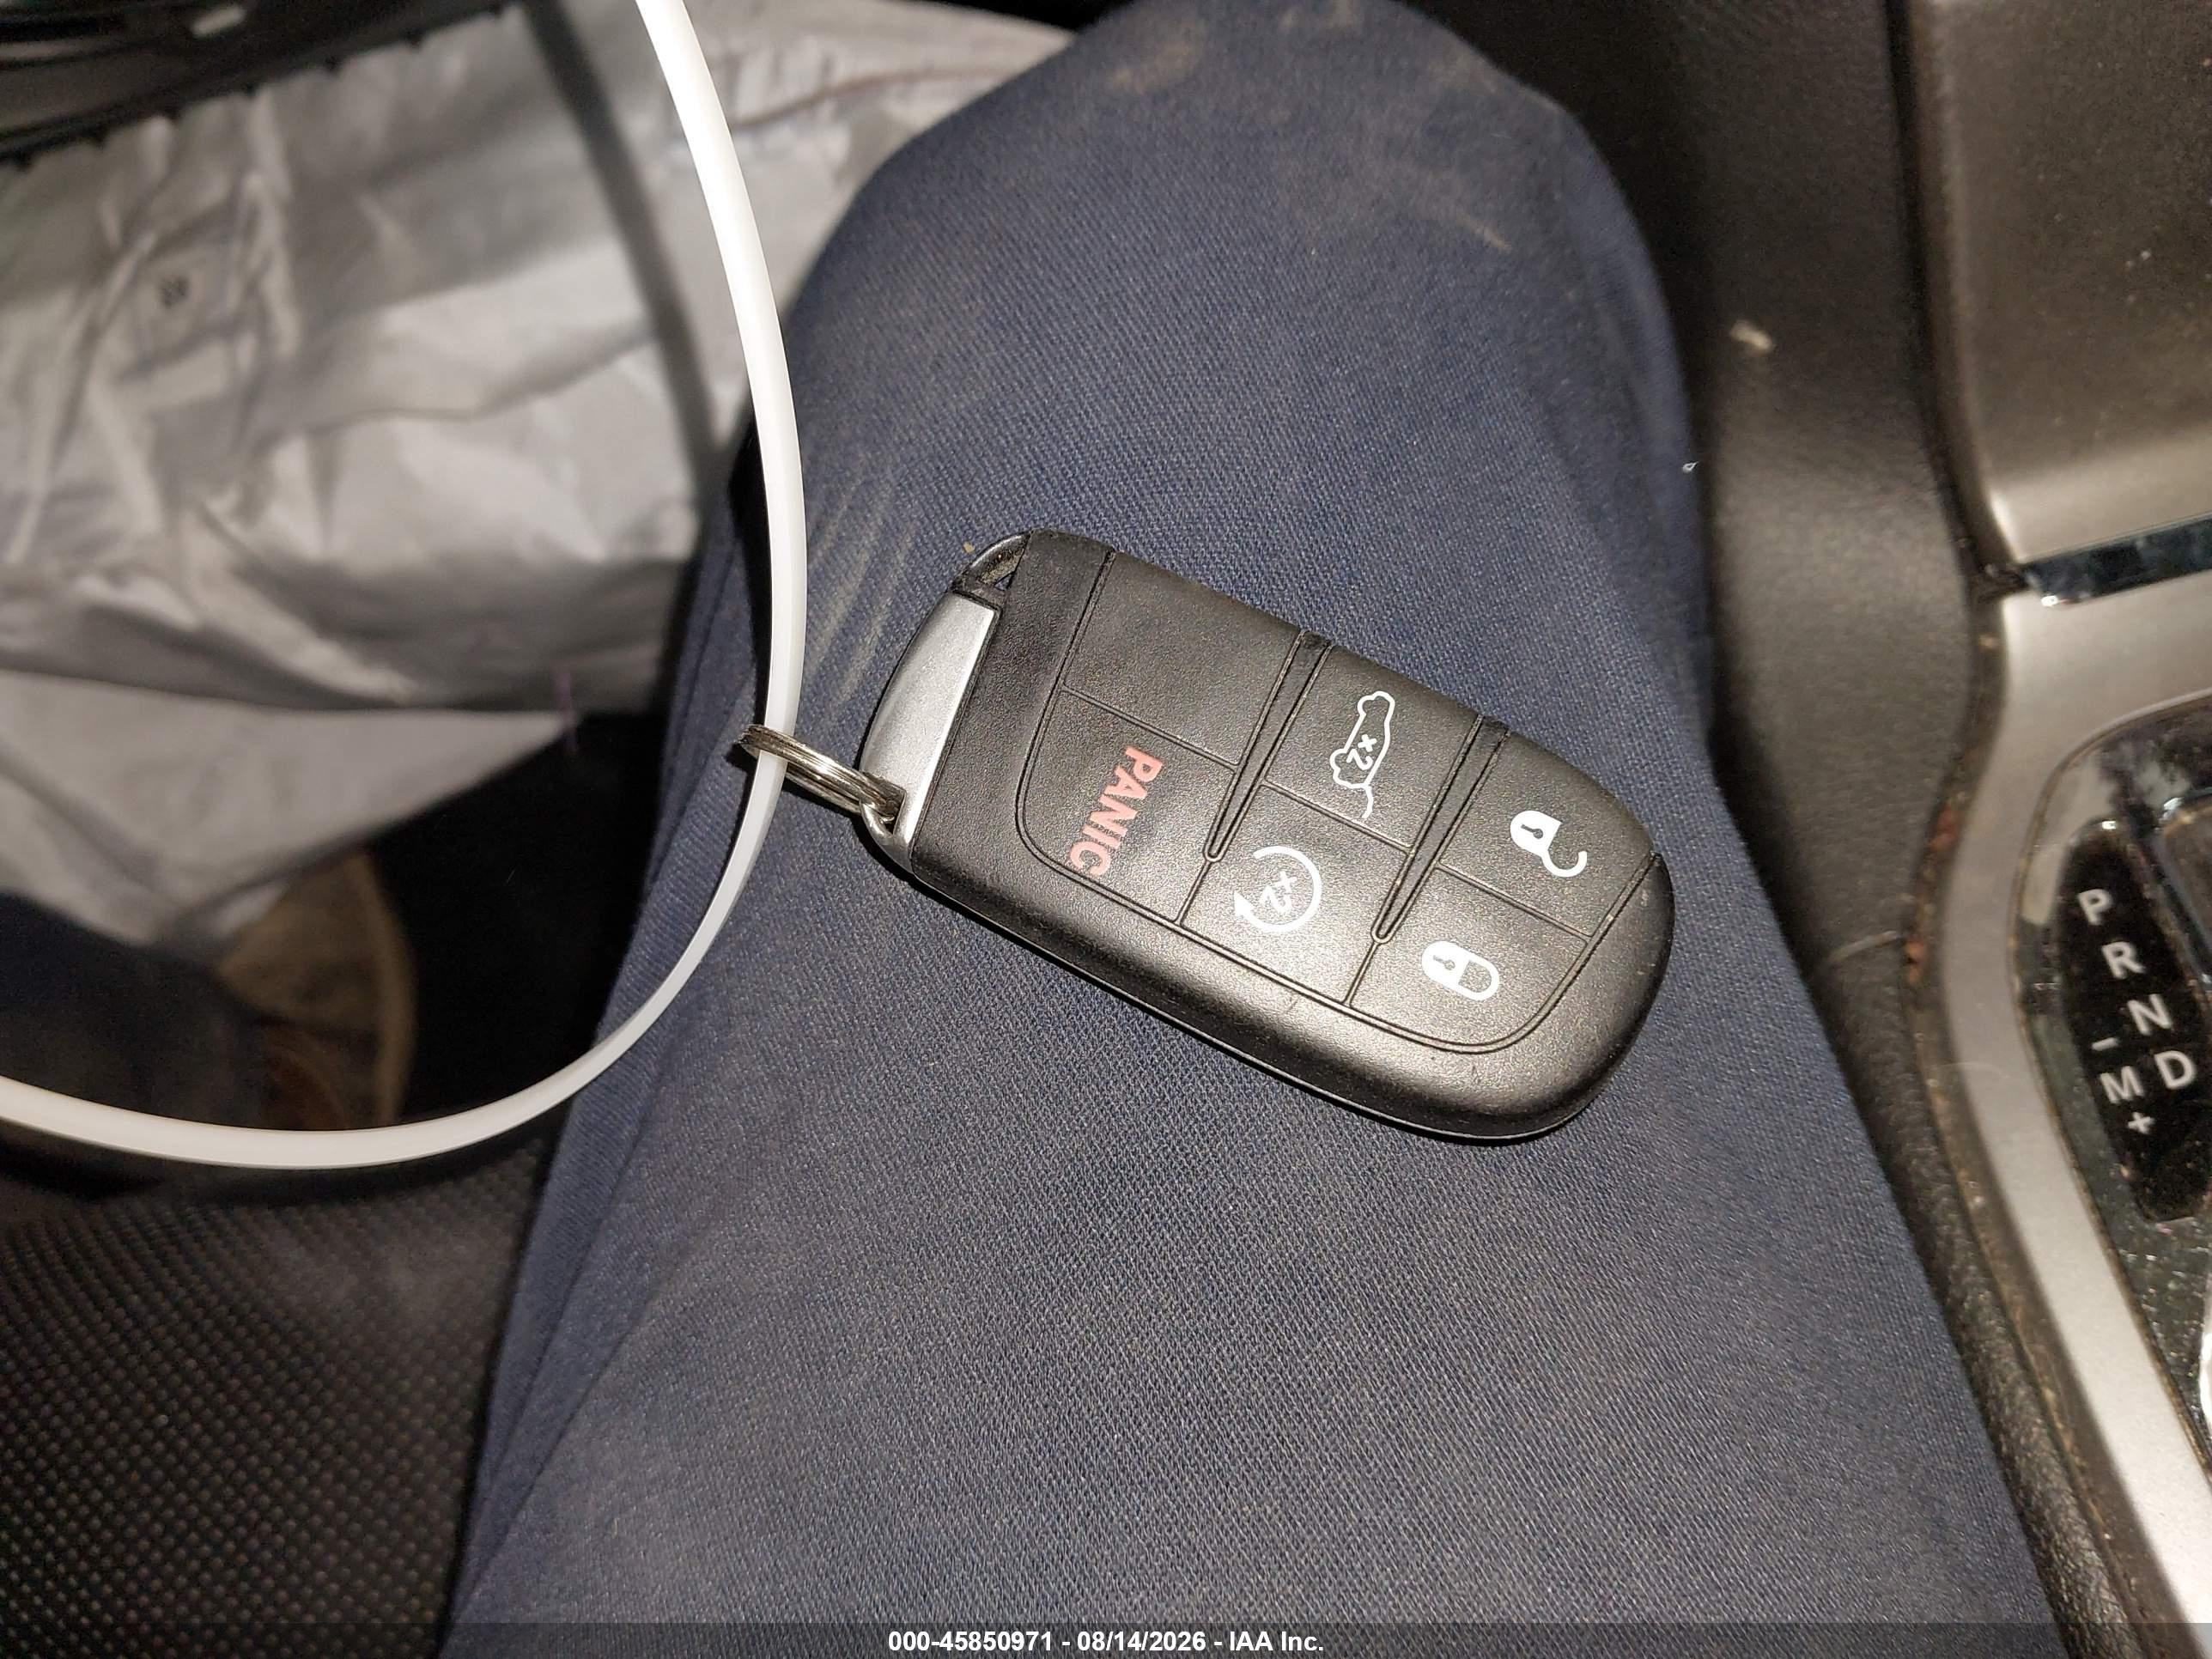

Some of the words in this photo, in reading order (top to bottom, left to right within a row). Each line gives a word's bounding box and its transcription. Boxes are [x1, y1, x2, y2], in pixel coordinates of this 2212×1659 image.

[1070, 745, 1164, 876] PANIC
[2078, 888, 2112, 925] P
[2101, 941, 2145, 979] R
[2127, 994, 2172, 1035] N
[2100, 1066, 2144, 1104] M
[2154, 1050, 2196, 1089] D
